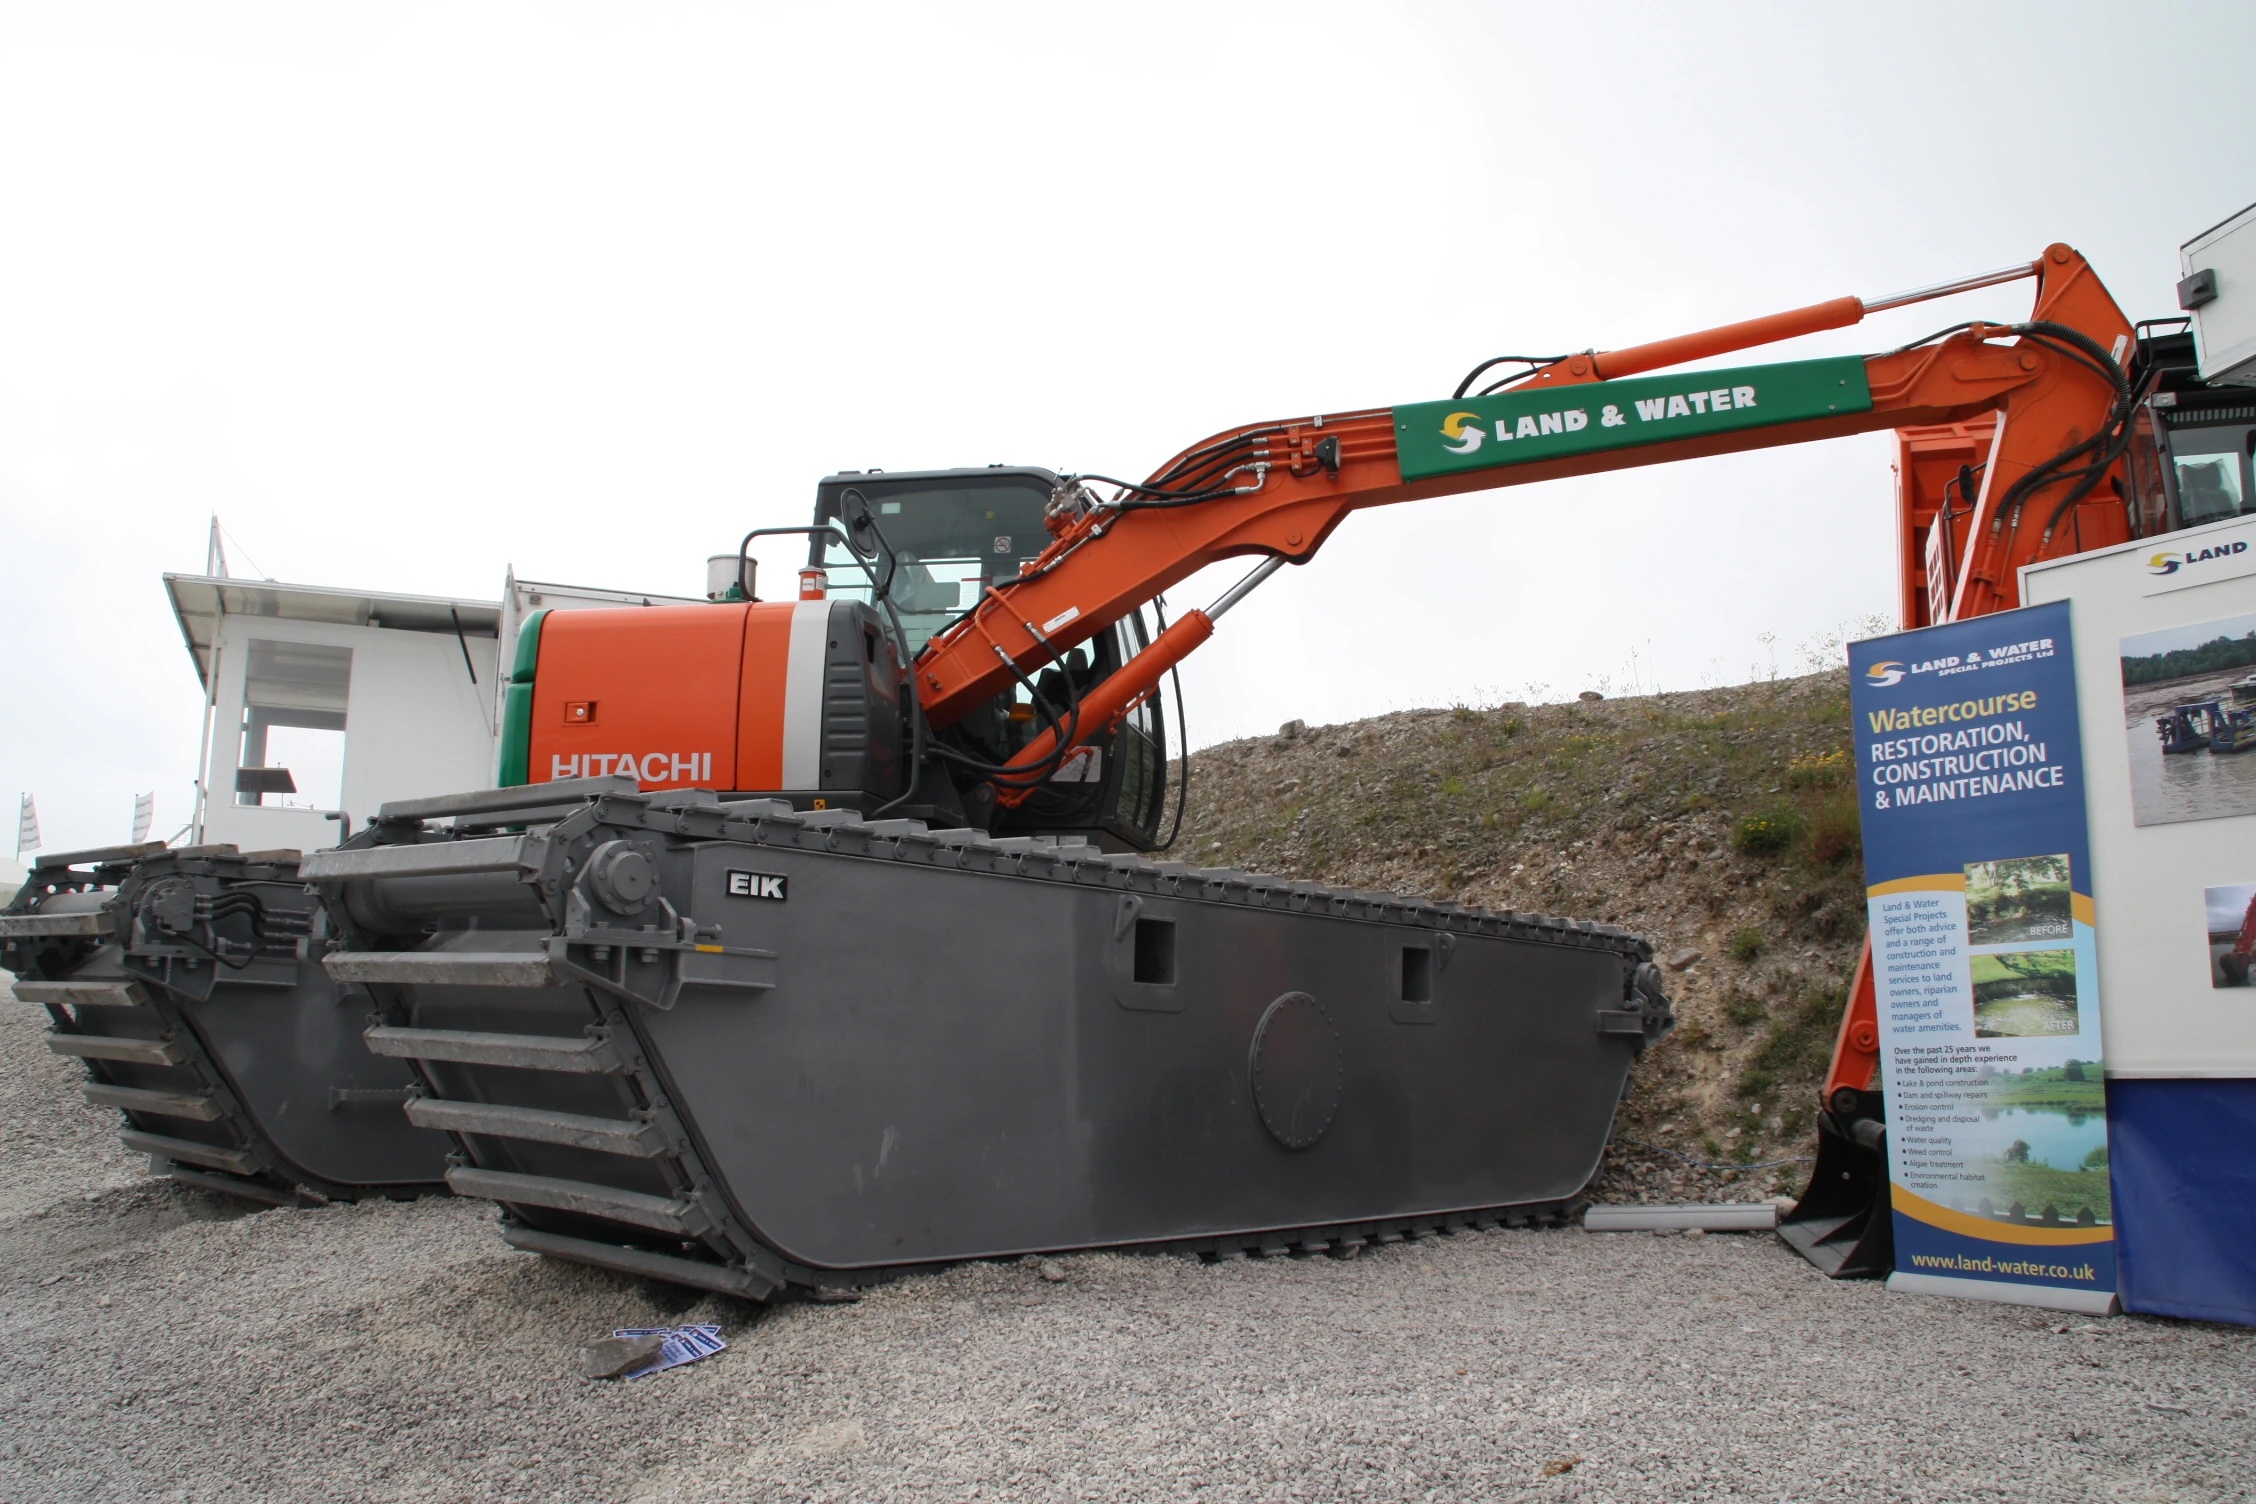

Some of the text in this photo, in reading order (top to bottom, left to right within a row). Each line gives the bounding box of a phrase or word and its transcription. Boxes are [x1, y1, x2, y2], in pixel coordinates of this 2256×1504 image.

[1496, 386, 1757, 442] LAND & WATER
[2185, 541, 2248, 564] LAND
[1911, 638, 2053, 674] LAND & WATER
[1938, 650, 2054, 677] SPECIAL PROJECTS Ltd
[1868, 690, 2037, 734] Watercourse
[1871, 720, 2031, 763] RESTORATION,
[552, 752, 711, 783] HITACHI
[1873, 743, 2046, 786] CONSTRUCTION
[1875, 766, 2064, 810] & MAINTENANCE
[729, 872, 784, 899] EIK
[1882, 900, 1939, 912] Land & Water
[1884, 911, 1947, 925] Special Projects
[1884, 922, 1956, 936] offer both advice
[2030, 924, 2068, 936] BEFORE
[1886, 938, 1900, 948] and
[1910, 938, 1934, 948] range
[1937, 934, 1947, 944] of
[1886, 947, 1956, 960] construction and
[1888, 962, 1940, 972] maintenance
[1888, 976, 1919, 984] services
[1933, 972, 1952, 982] land
[1890, 985, 1958, 997] owners, riparian
[1890, 998, 1938, 1009] owners and
[1892, 1010, 1942, 1022] managers of
[1892, 1022, 1962, 1033] water amenities.
[2043, 1020, 2074, 1031] AFTER
[1894, 1047, 1911, 1055] Over
[1926, 1046, 1942, 1056] past
[1944, 1046, 1954, 1054] 25
[1956, 1046, 1976, 1057] years
[1894, 1054, 2018, 1066] have gained in depth experience
[1904, 1066, 1916, 1074] the
[1918, 1065, 1953, 1076] following
[1926, 1080, 1944, 1088] pond
[1946, 1078, 1988, 1087] construction
[1934, 1090, 1962, 1100] spillway
[1964, 1091, 1988, 1100] repairs
[1930, 1103, 1954, 1111] control
[1906, 1115, 1936, 1124] Dredging
[1952, 1115, 1980, 1124] disposal
[1928, 1137, 1952, 1146] quality
[1909, 1160, 1964, 1168] Algae treatment
[1910, 1172, 1958, 1180] Environmental
[1912, 1254, 2096, 1281] www.land-water.co.uk
